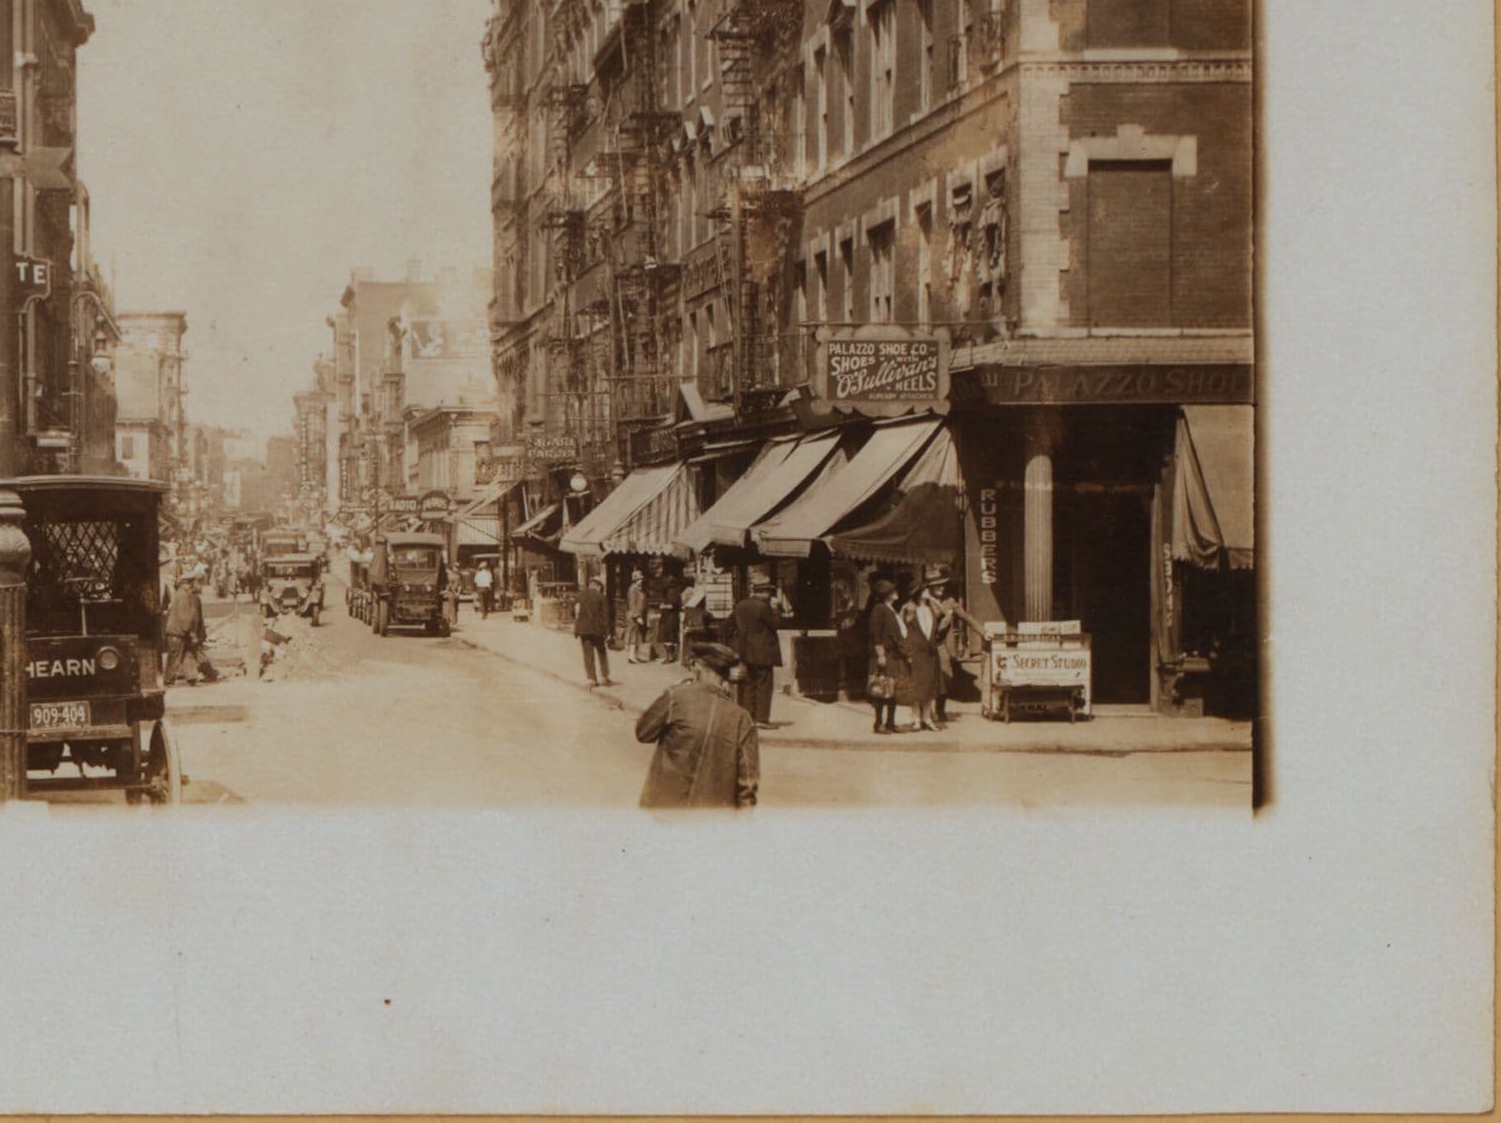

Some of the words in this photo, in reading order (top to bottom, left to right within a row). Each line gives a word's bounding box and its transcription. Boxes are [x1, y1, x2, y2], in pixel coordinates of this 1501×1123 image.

[829, 343, 875, 355] PALAZZO
[879, 343, 908, 355] SHOE
[831, 356, 876, 376] SHOES
[836, 356, 937, 399] O'Sullivan's
[895, 371, 937, 391] HEELS
[1014, 371, 1153, 397] PALAZZO
[388, 499, 418, 512] RADIO
[980, 488, 997, 585] RUBBERS
[1013, 653, 1049, 670] SECRET
[1051, 653, 1088, 670] STUDIO
